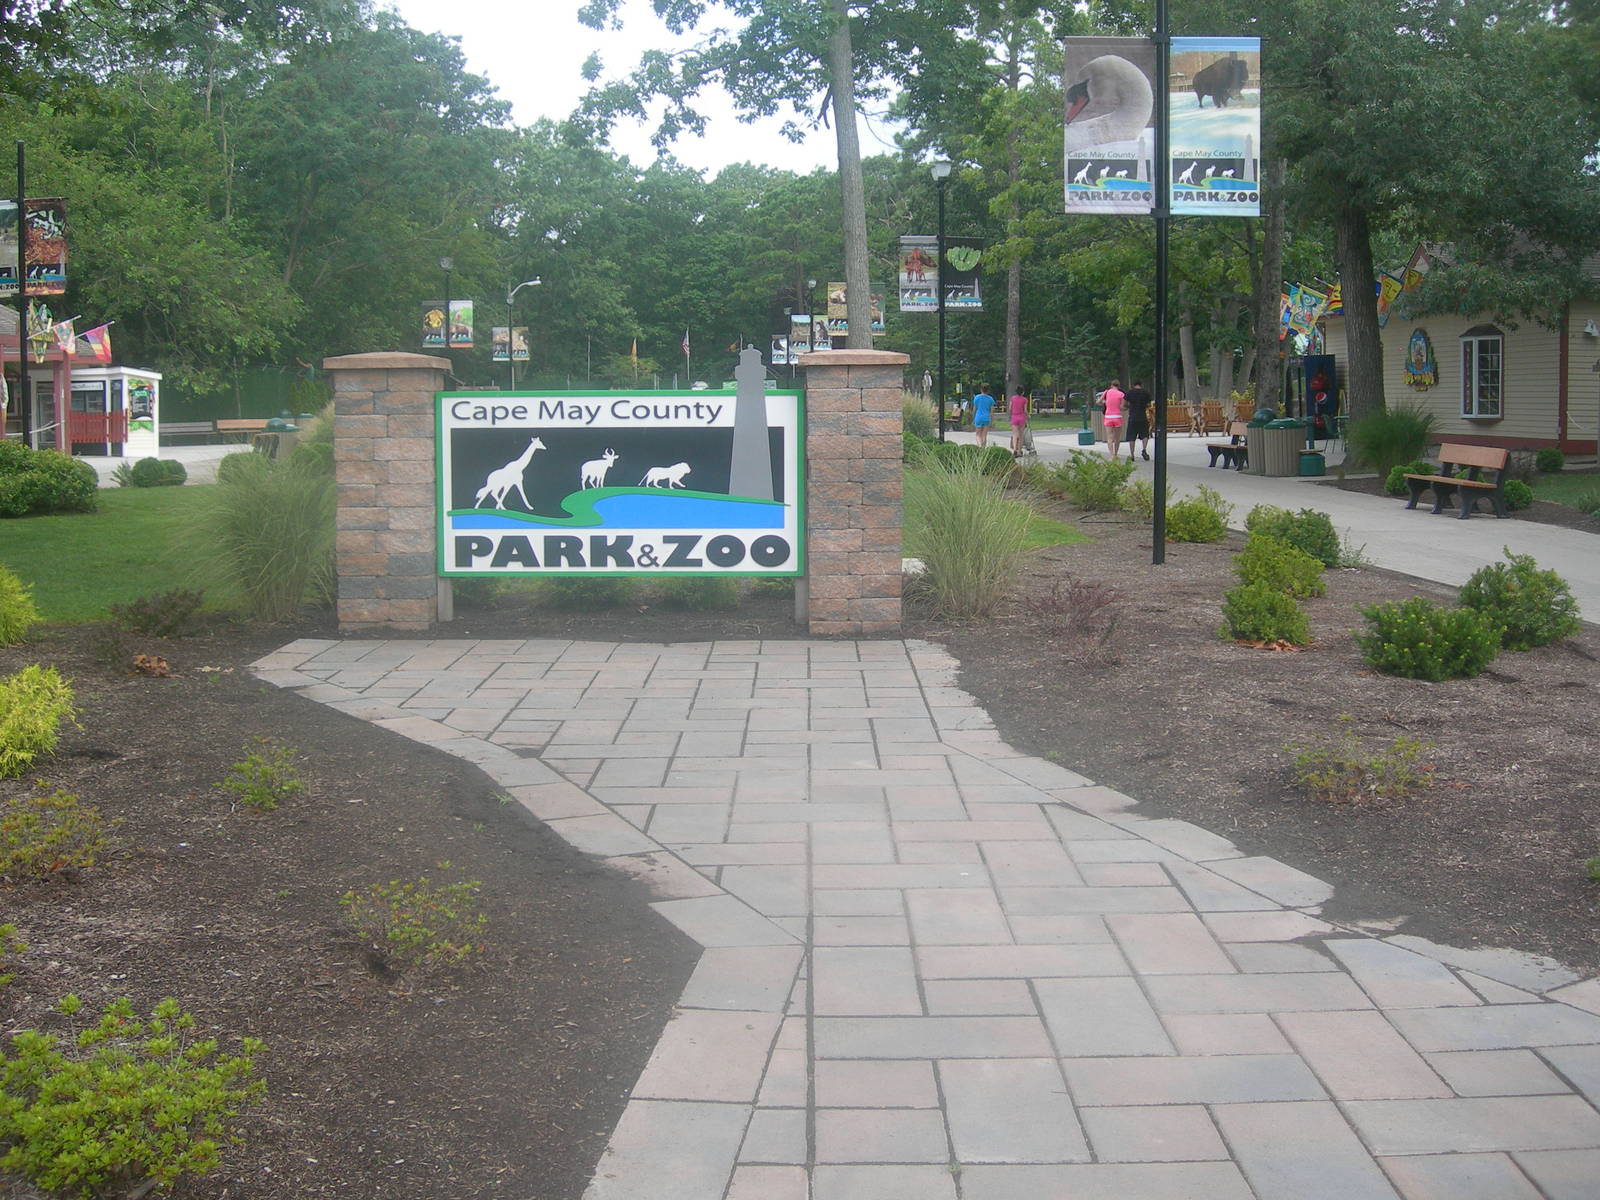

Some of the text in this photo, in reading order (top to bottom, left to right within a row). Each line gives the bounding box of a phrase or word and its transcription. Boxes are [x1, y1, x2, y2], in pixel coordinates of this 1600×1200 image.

[1068, 151, 1137, 160] Cape May County
[1173, 150, 1243, 159] Cape May County
[451, 400, 723, 425] Cape May County
